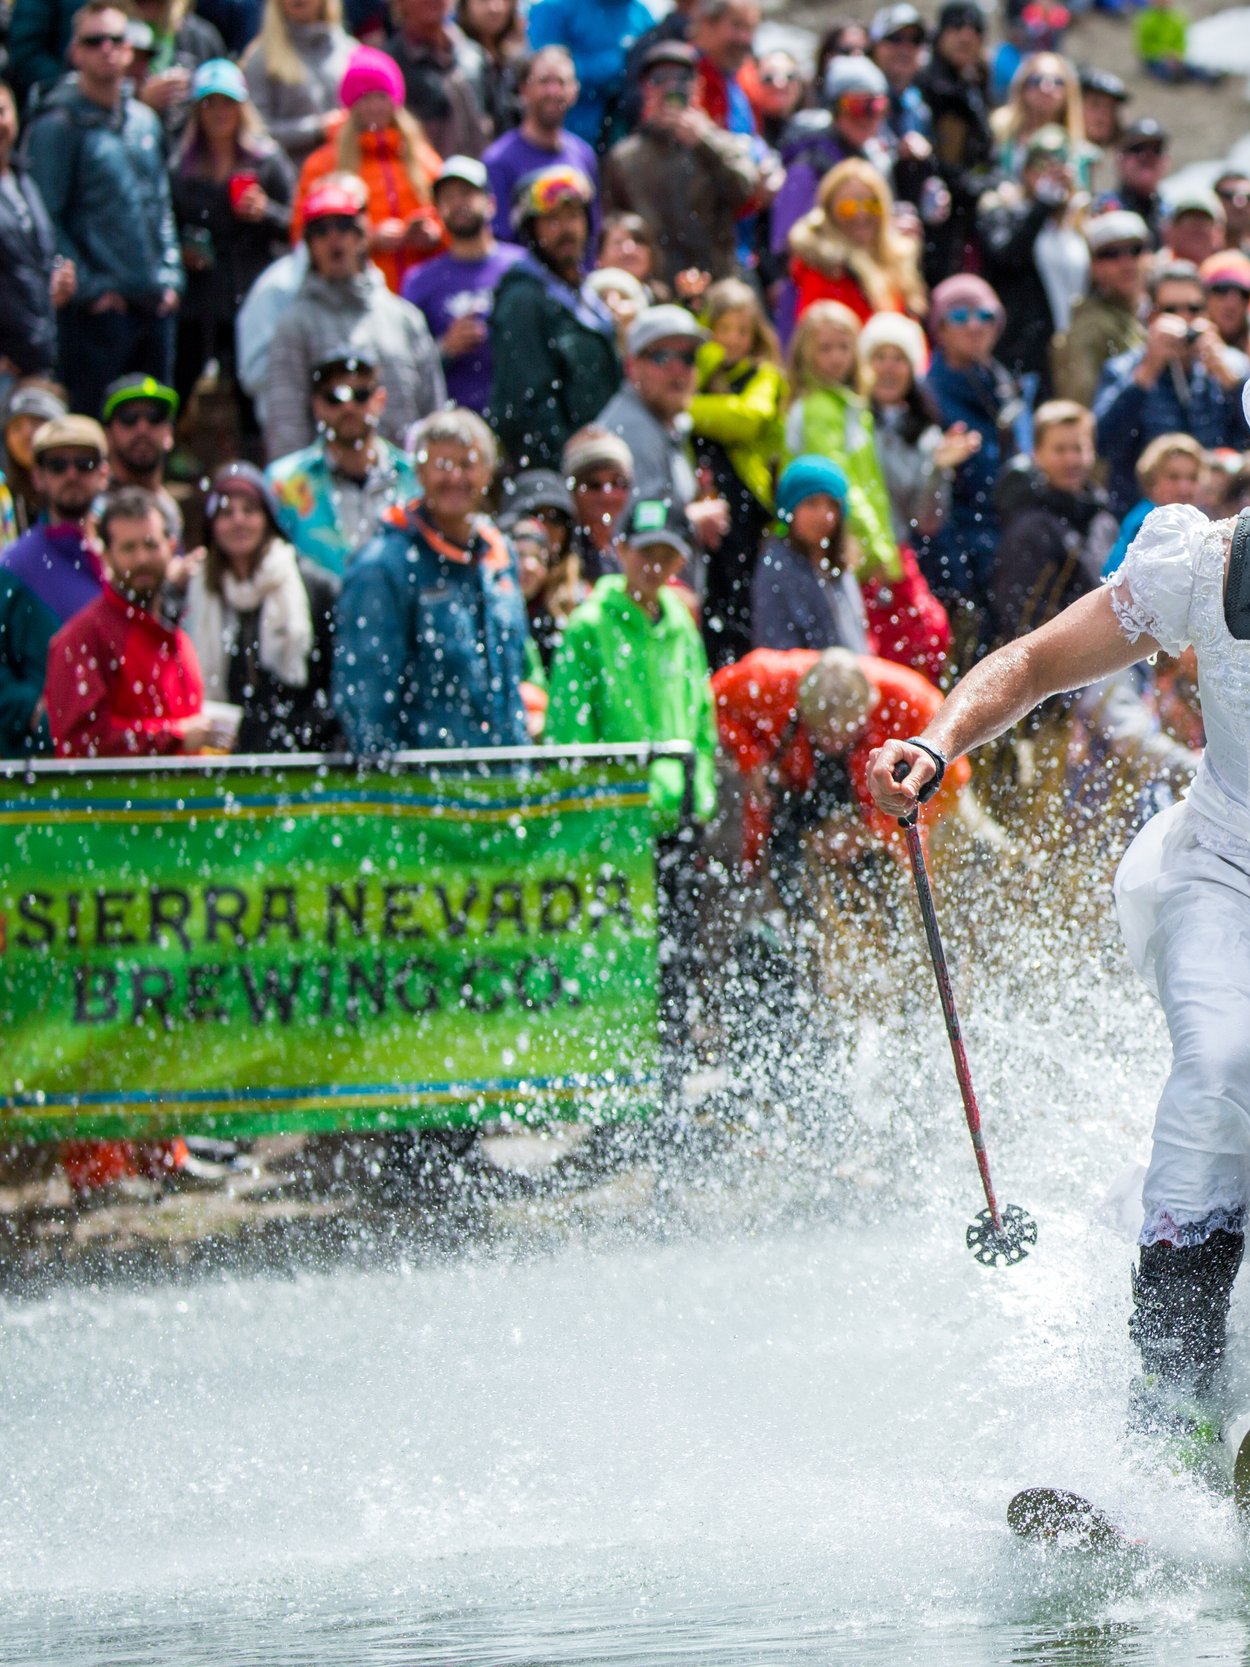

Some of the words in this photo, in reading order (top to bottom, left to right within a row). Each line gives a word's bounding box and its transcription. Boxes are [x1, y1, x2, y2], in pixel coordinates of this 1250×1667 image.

[15, 884, 301, 952] SIERRA
[326, 874, 635, 946] NEVADA
[71, 955, 440, 1029] BREWING
